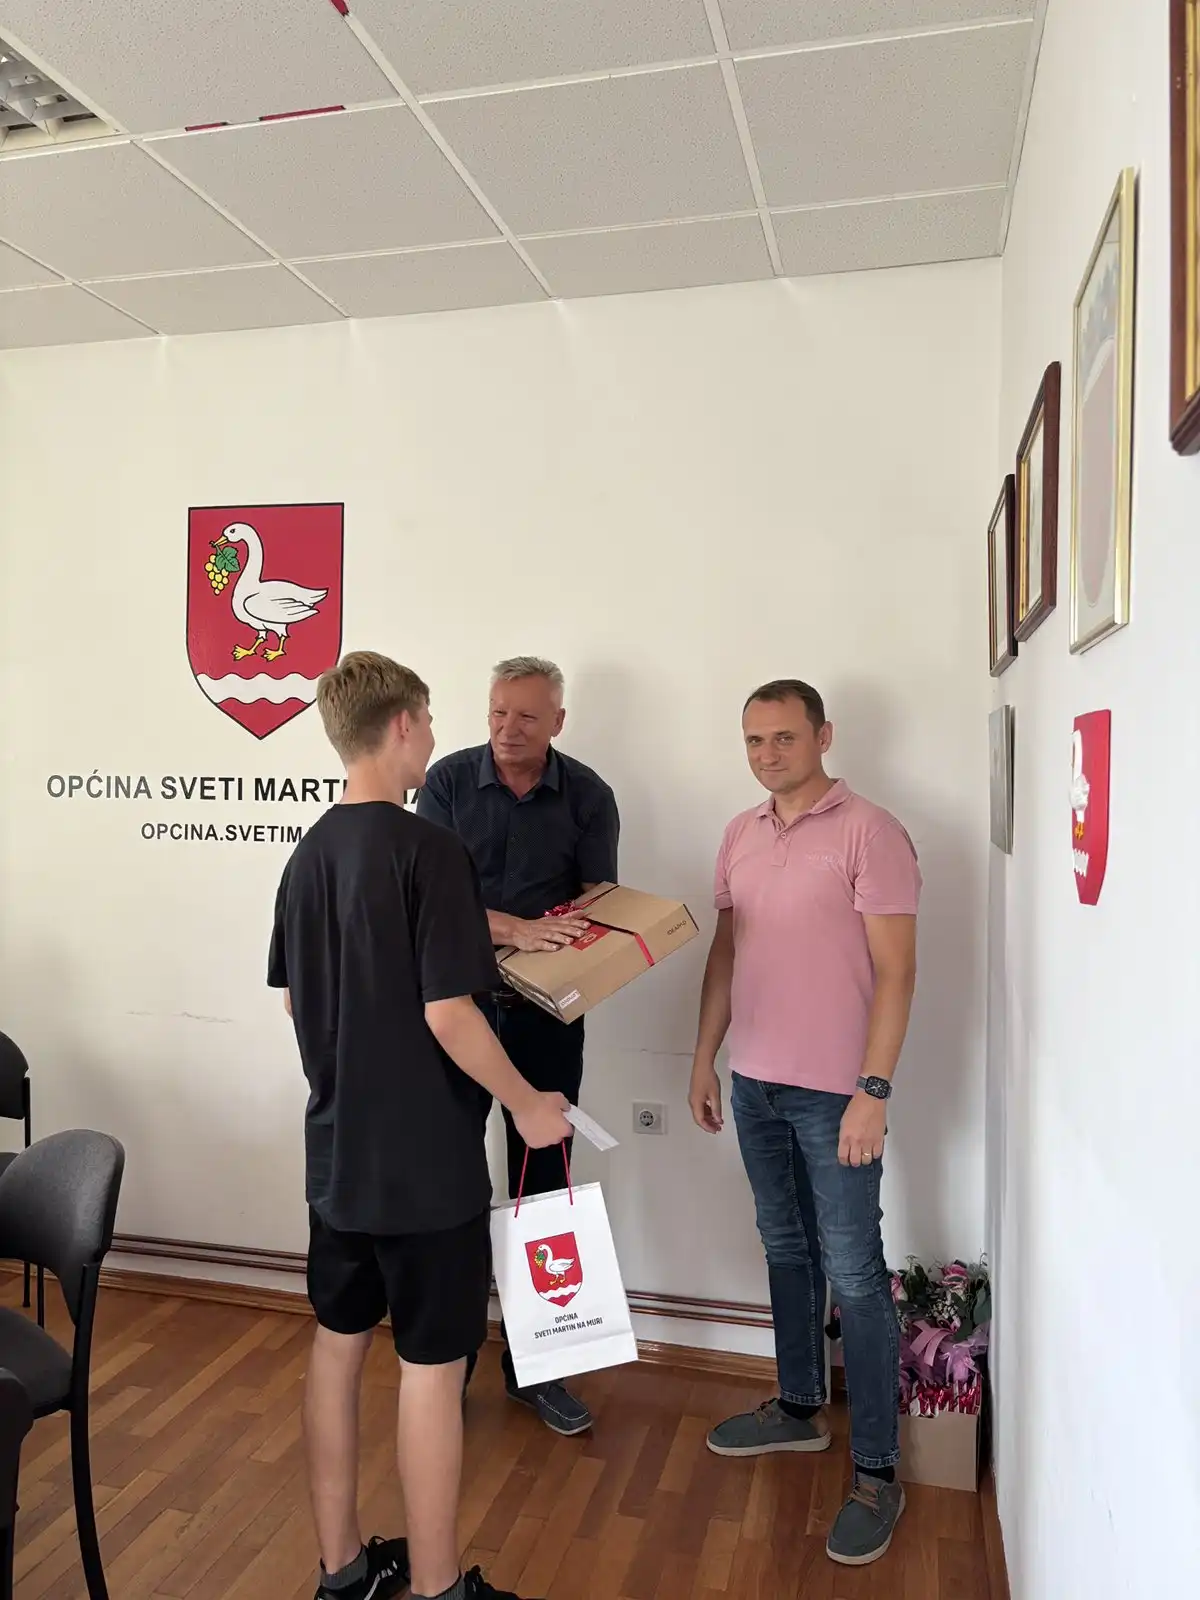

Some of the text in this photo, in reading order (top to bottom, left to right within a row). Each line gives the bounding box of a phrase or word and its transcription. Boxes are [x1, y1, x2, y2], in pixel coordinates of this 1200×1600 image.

[46, 769, 347, 803] OPĆINA SVETI MARTI
[141, 822, 302, 844] OPCINA.SVETIM
[534, 1317, 603, 1339] SVETI MARTIN NA MURI
